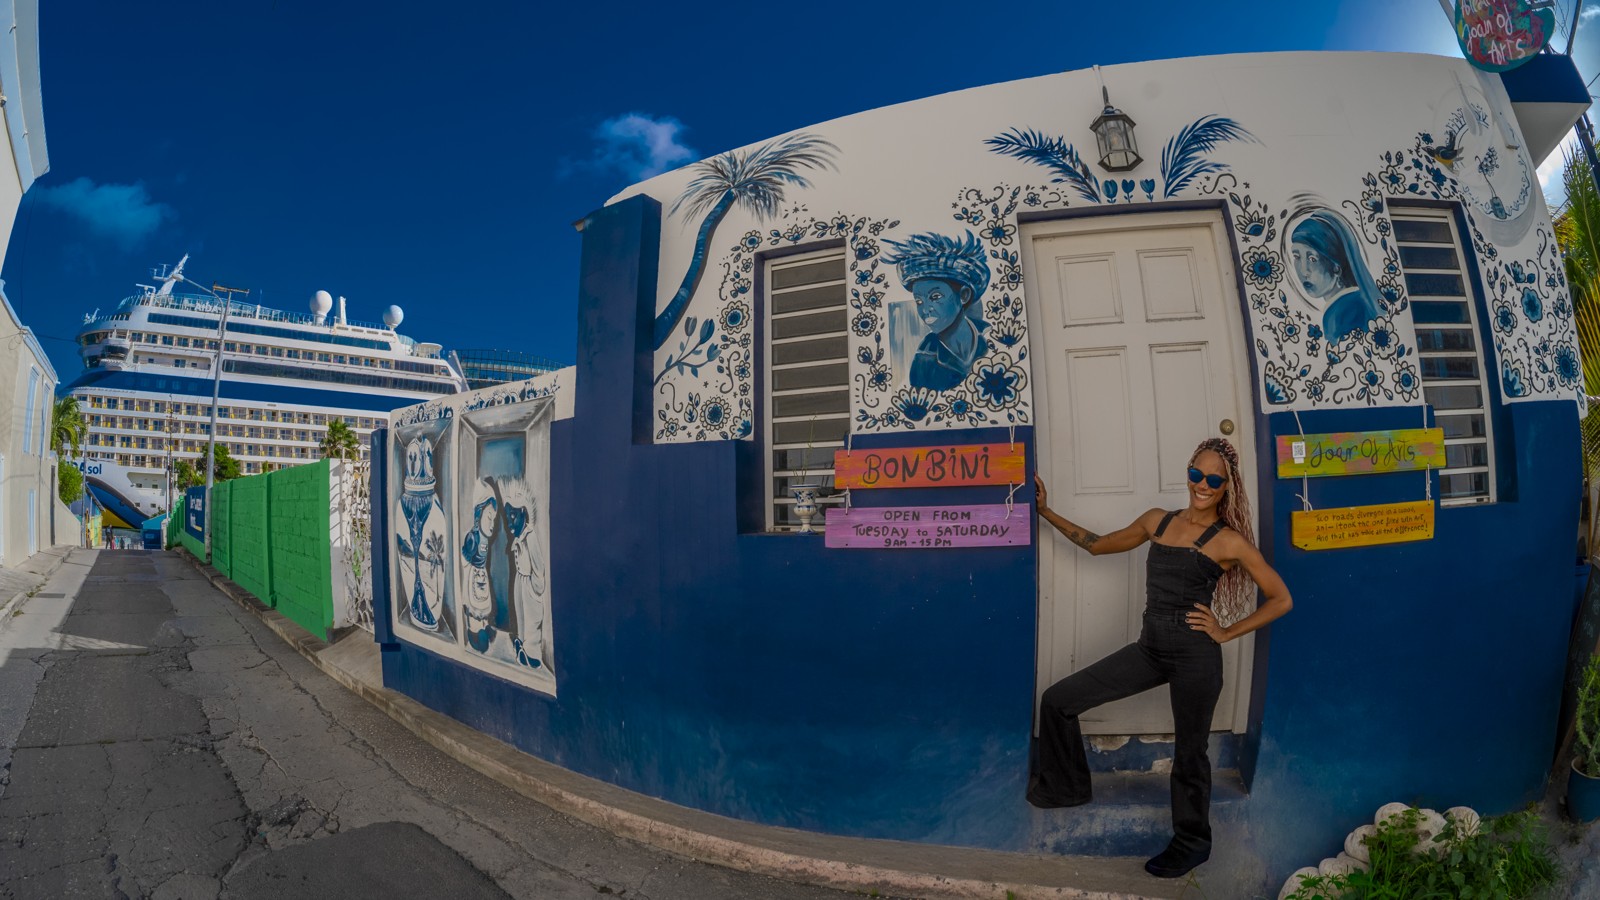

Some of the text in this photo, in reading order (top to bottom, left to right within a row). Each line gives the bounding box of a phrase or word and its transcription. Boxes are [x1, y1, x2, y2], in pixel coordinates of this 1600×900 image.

[863, 454, 919, 484] BON
[884, 510, 971, 521] OPEN FROM
[916, 528, 928, 536] to
[937, 525, 1010, 538] SATURDAY
